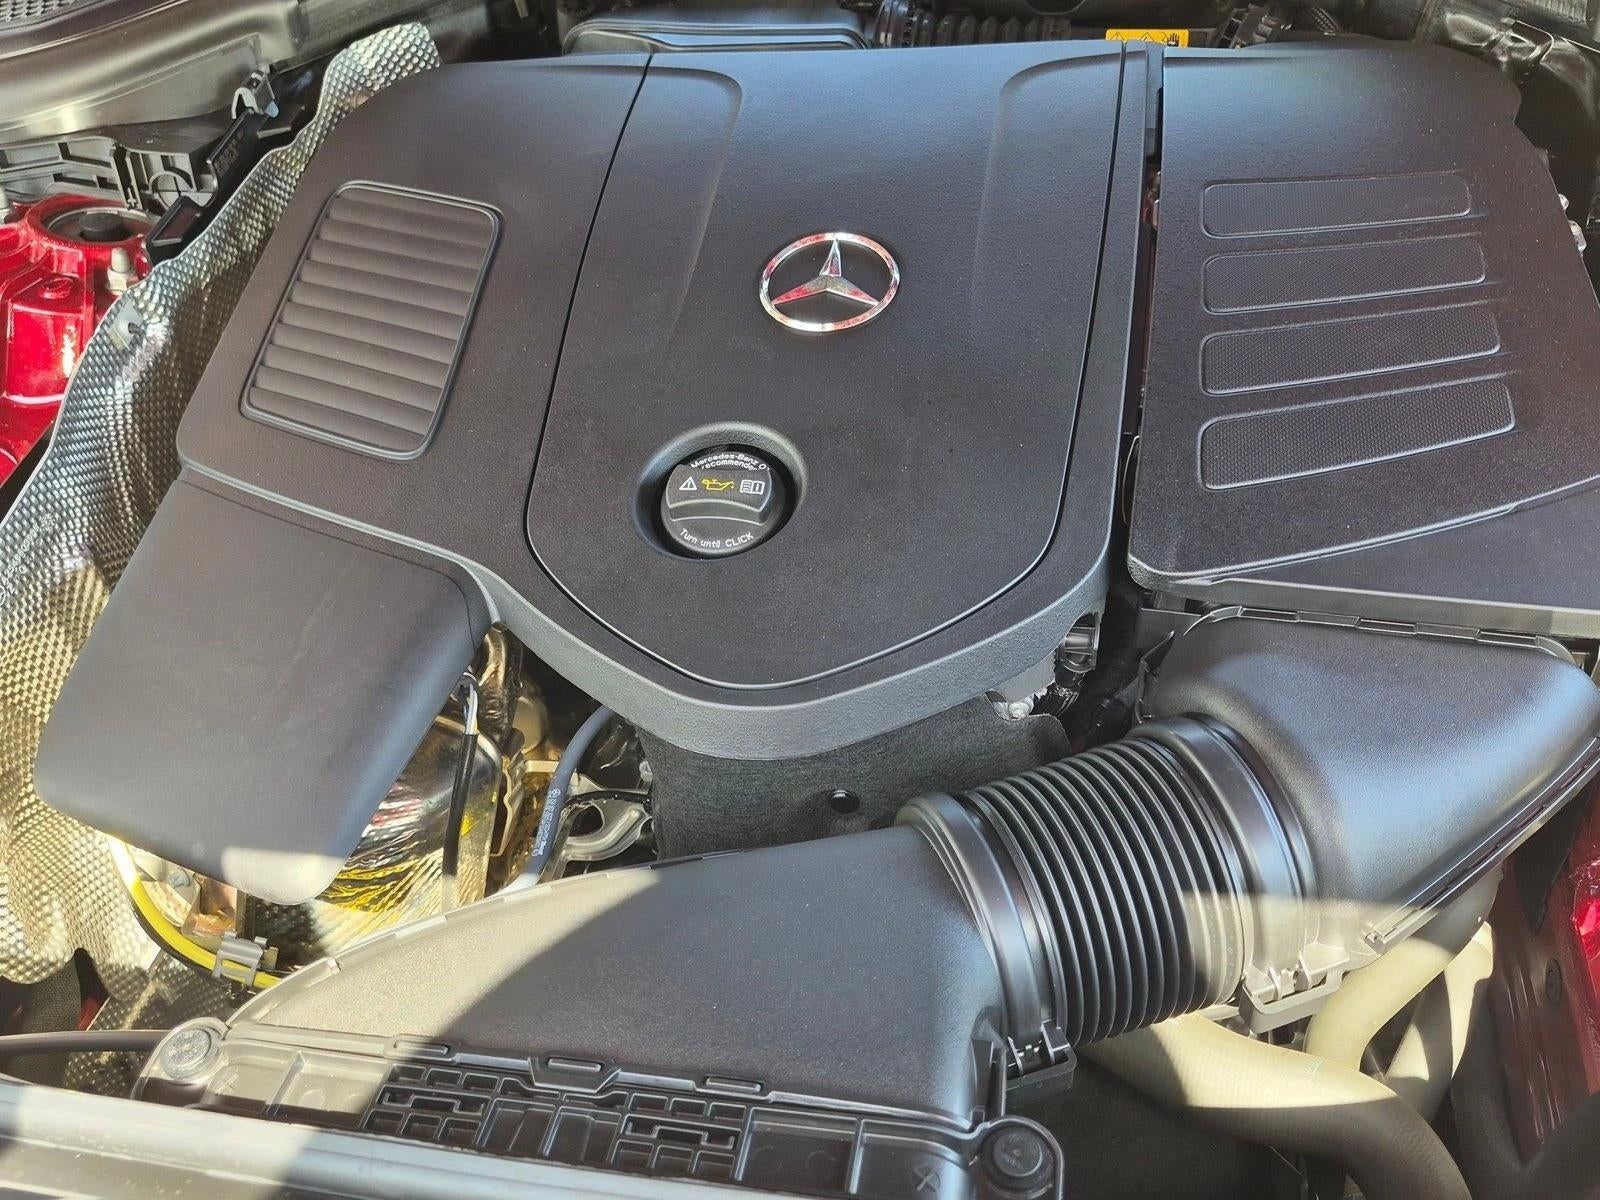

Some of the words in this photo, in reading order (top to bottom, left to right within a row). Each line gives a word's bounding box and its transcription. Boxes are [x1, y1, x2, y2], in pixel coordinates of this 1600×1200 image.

[690, 453, 759, 468] Mercedes-Benz
[680, 528, 698, 544] Turn
[700, 539, 720, 549] until
[725, 532, 754, 547] CLICK
